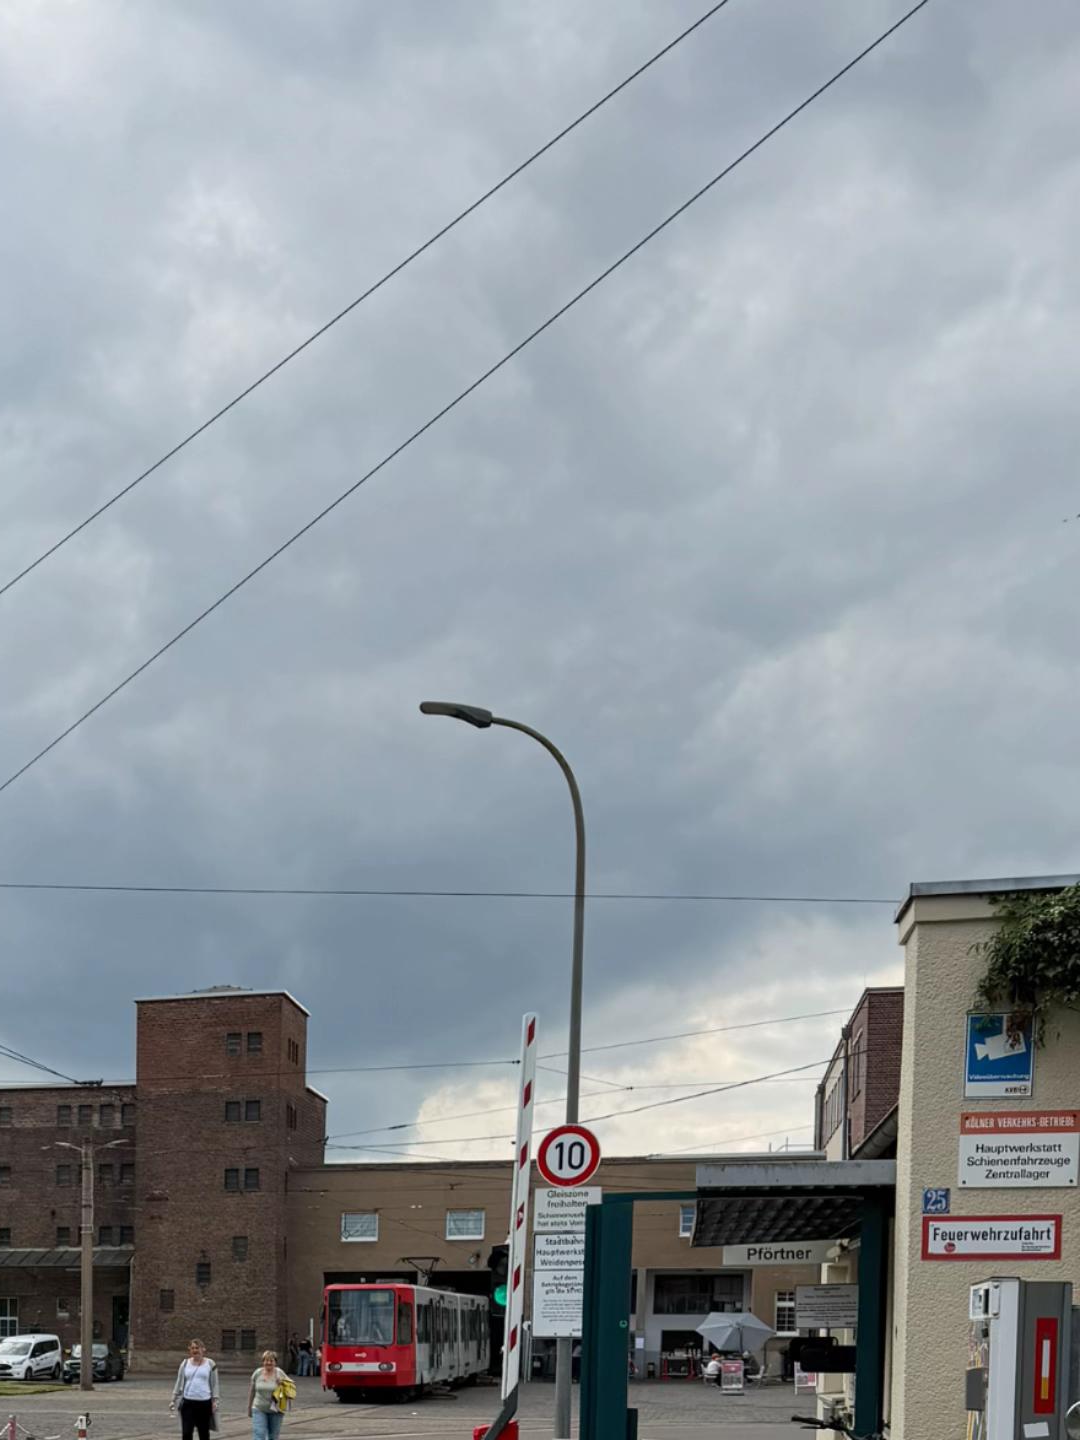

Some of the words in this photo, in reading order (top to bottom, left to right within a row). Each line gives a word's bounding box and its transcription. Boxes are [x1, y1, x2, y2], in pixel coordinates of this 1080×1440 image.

[965, 1115, 995, 1129] KÖLNER
[997, 1115, 1075, 1128] VERKEHRS-BETRIEBE
[975, 1143, 1062, 1155] Hauptwerkstatt
[555, 1141, 585, 1170] 10
[966, 1156, 1071, 1168] Schienenfahrzeuge
[985, 1169, 1050, 1181] Zentrallager
[547, 1190, 589, 1198] Gleiszone
[926, 1190, 947, 1211] 25
[537, 1211, 585, 1219] Schienenverk
[933, 1226, 1052, 1241] Feuerwehrzufahrt
[536, 1248, 585, 1257] Hauptwerkst
[747, 1246, 812, 1260] Pförtner
[540, 1259, 584, 1267] Weidenpes
